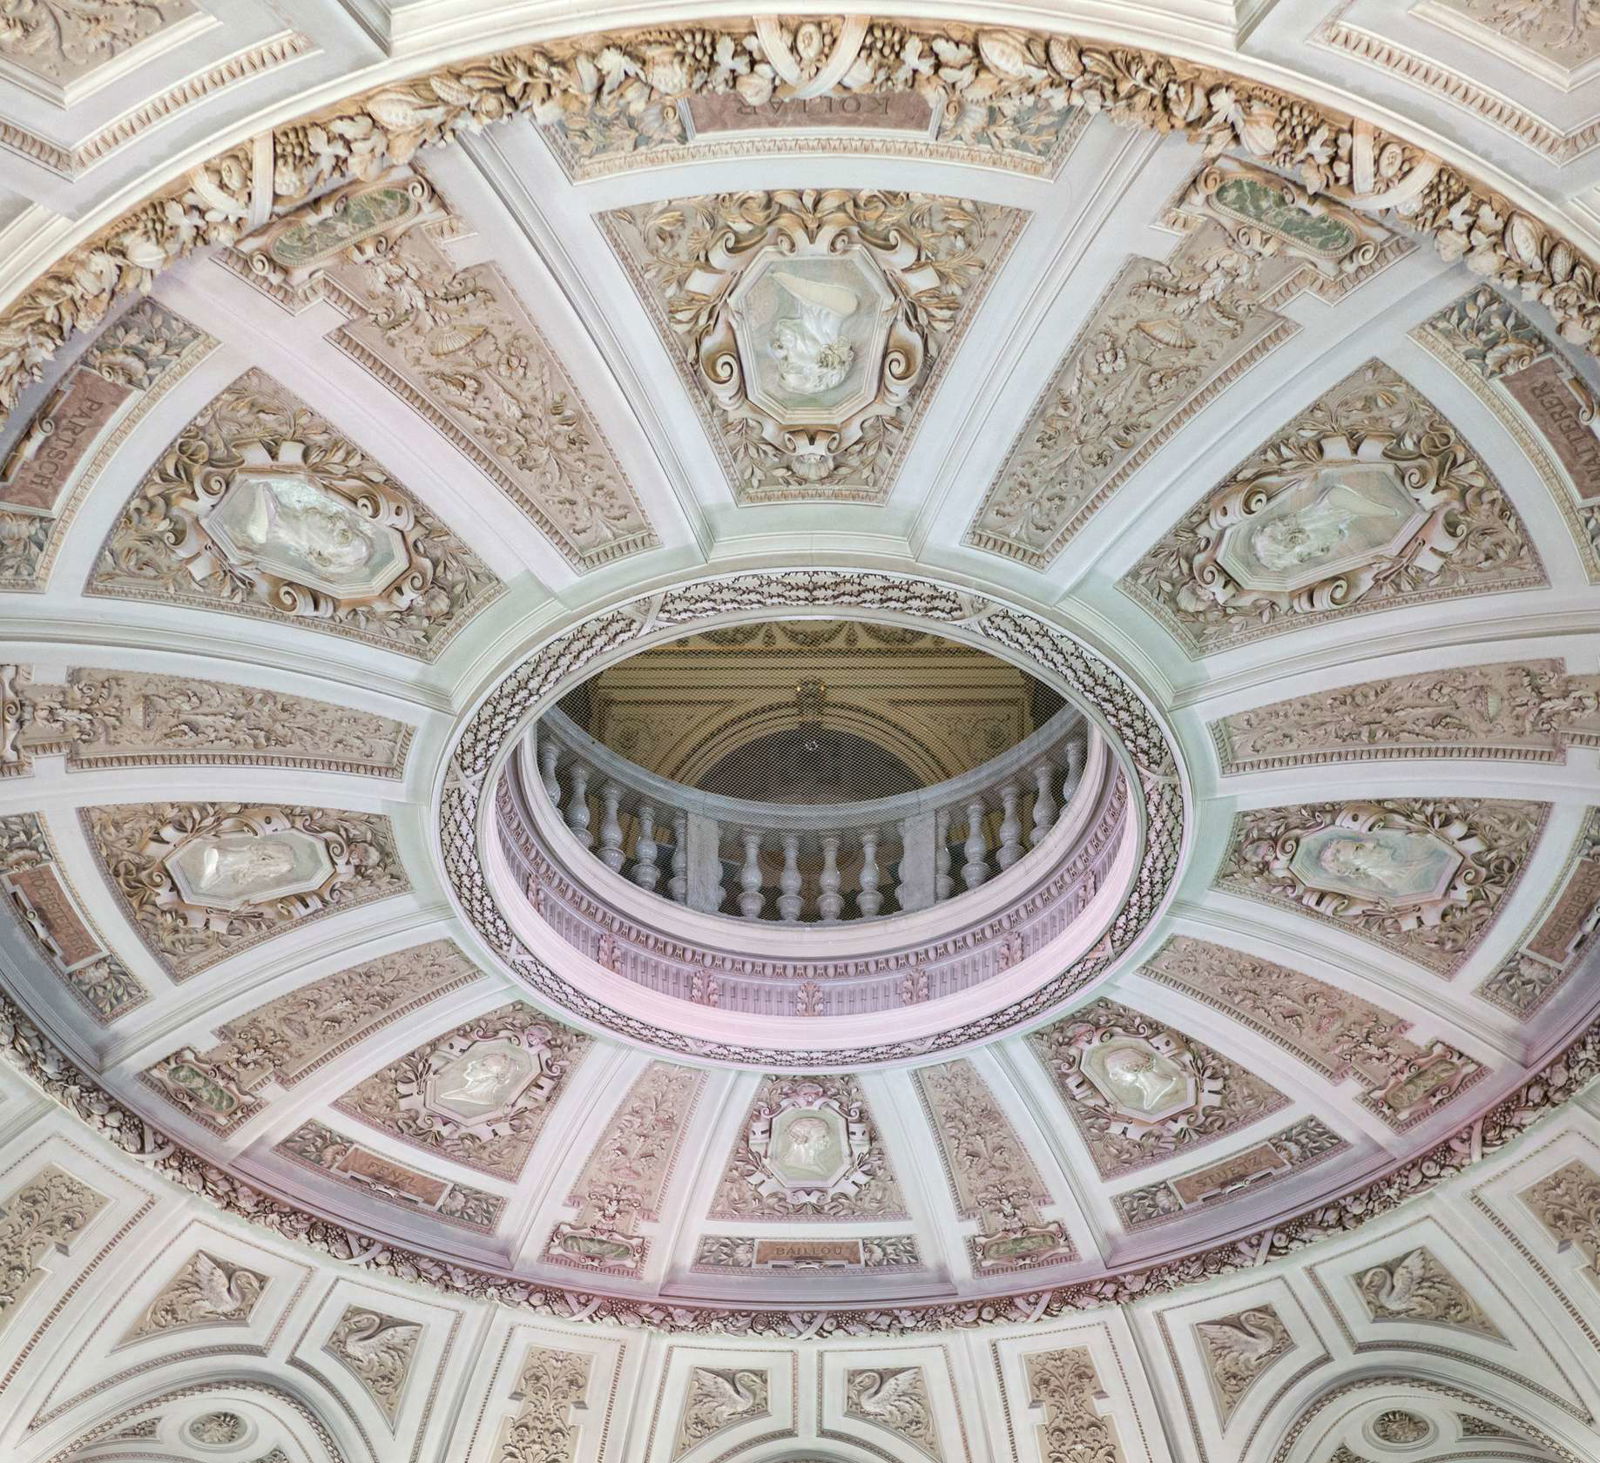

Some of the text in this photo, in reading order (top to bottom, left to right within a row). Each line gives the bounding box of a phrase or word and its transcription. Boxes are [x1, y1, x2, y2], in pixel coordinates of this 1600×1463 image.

[30, 397, 105, 490] PARTSCH
[366, 1160, 418, 1187] FENZL
[1195, 1154, 1260, 1188] STUETZ
[775, 1246, 842, 1256] BAILLOU
